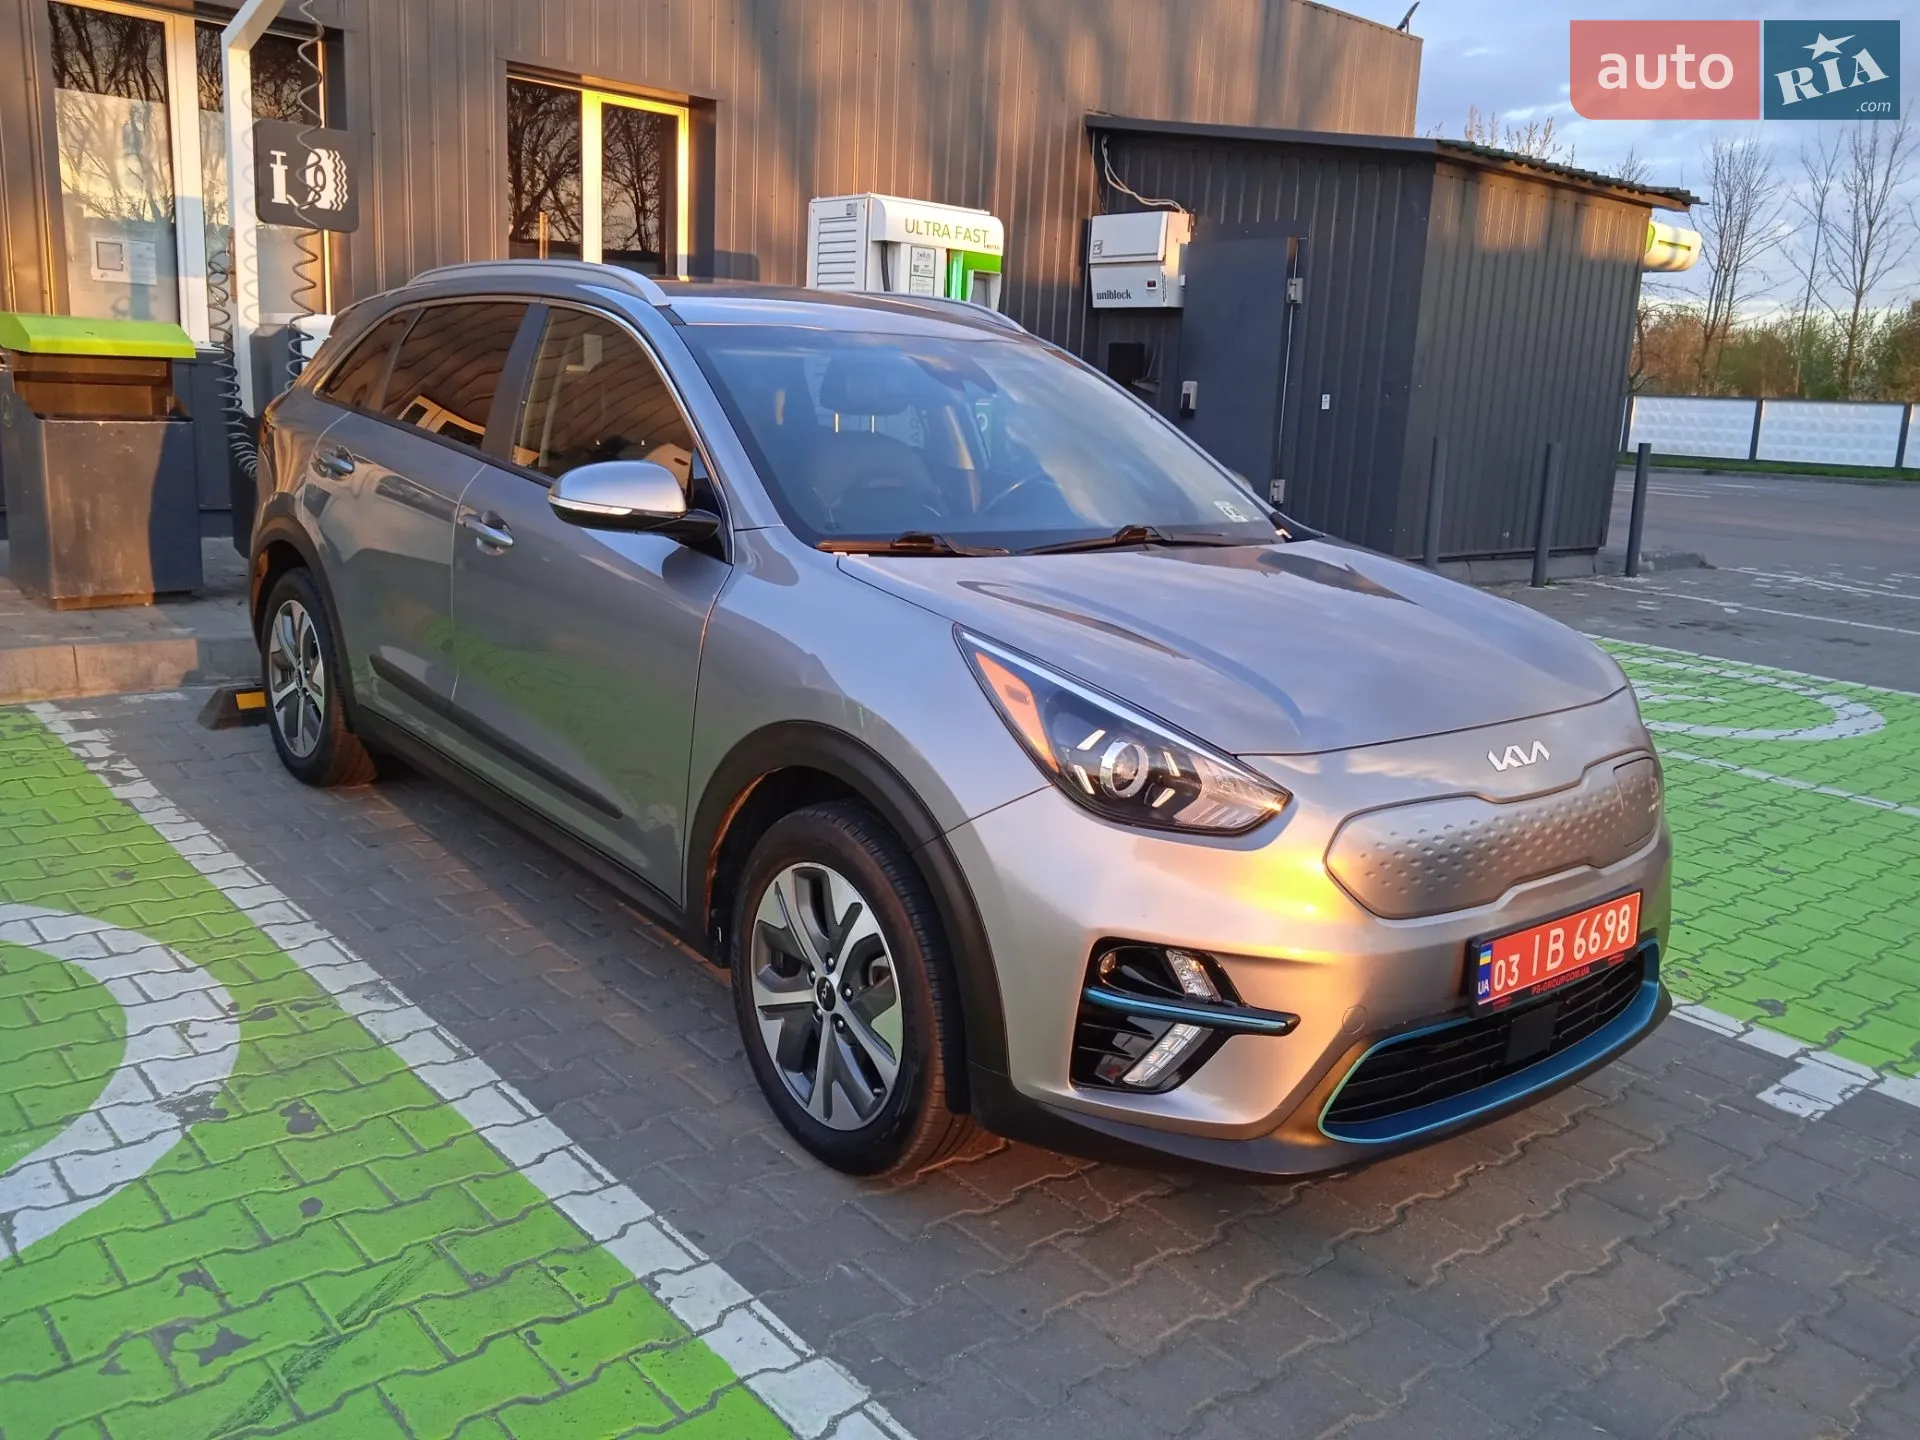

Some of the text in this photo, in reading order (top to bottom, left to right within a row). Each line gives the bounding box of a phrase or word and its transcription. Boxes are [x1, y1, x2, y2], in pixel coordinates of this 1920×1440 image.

[905, 217, 989, 244] ULTRA FAST
[1096, 289, 1132, 300] uniblock
[1487, 740, 1550, 772] KIA
[1493, 953, 1520, 991] 03
[1573, 903, 1631, 961] 6698
[1477, 979, 1490, 995] UA
